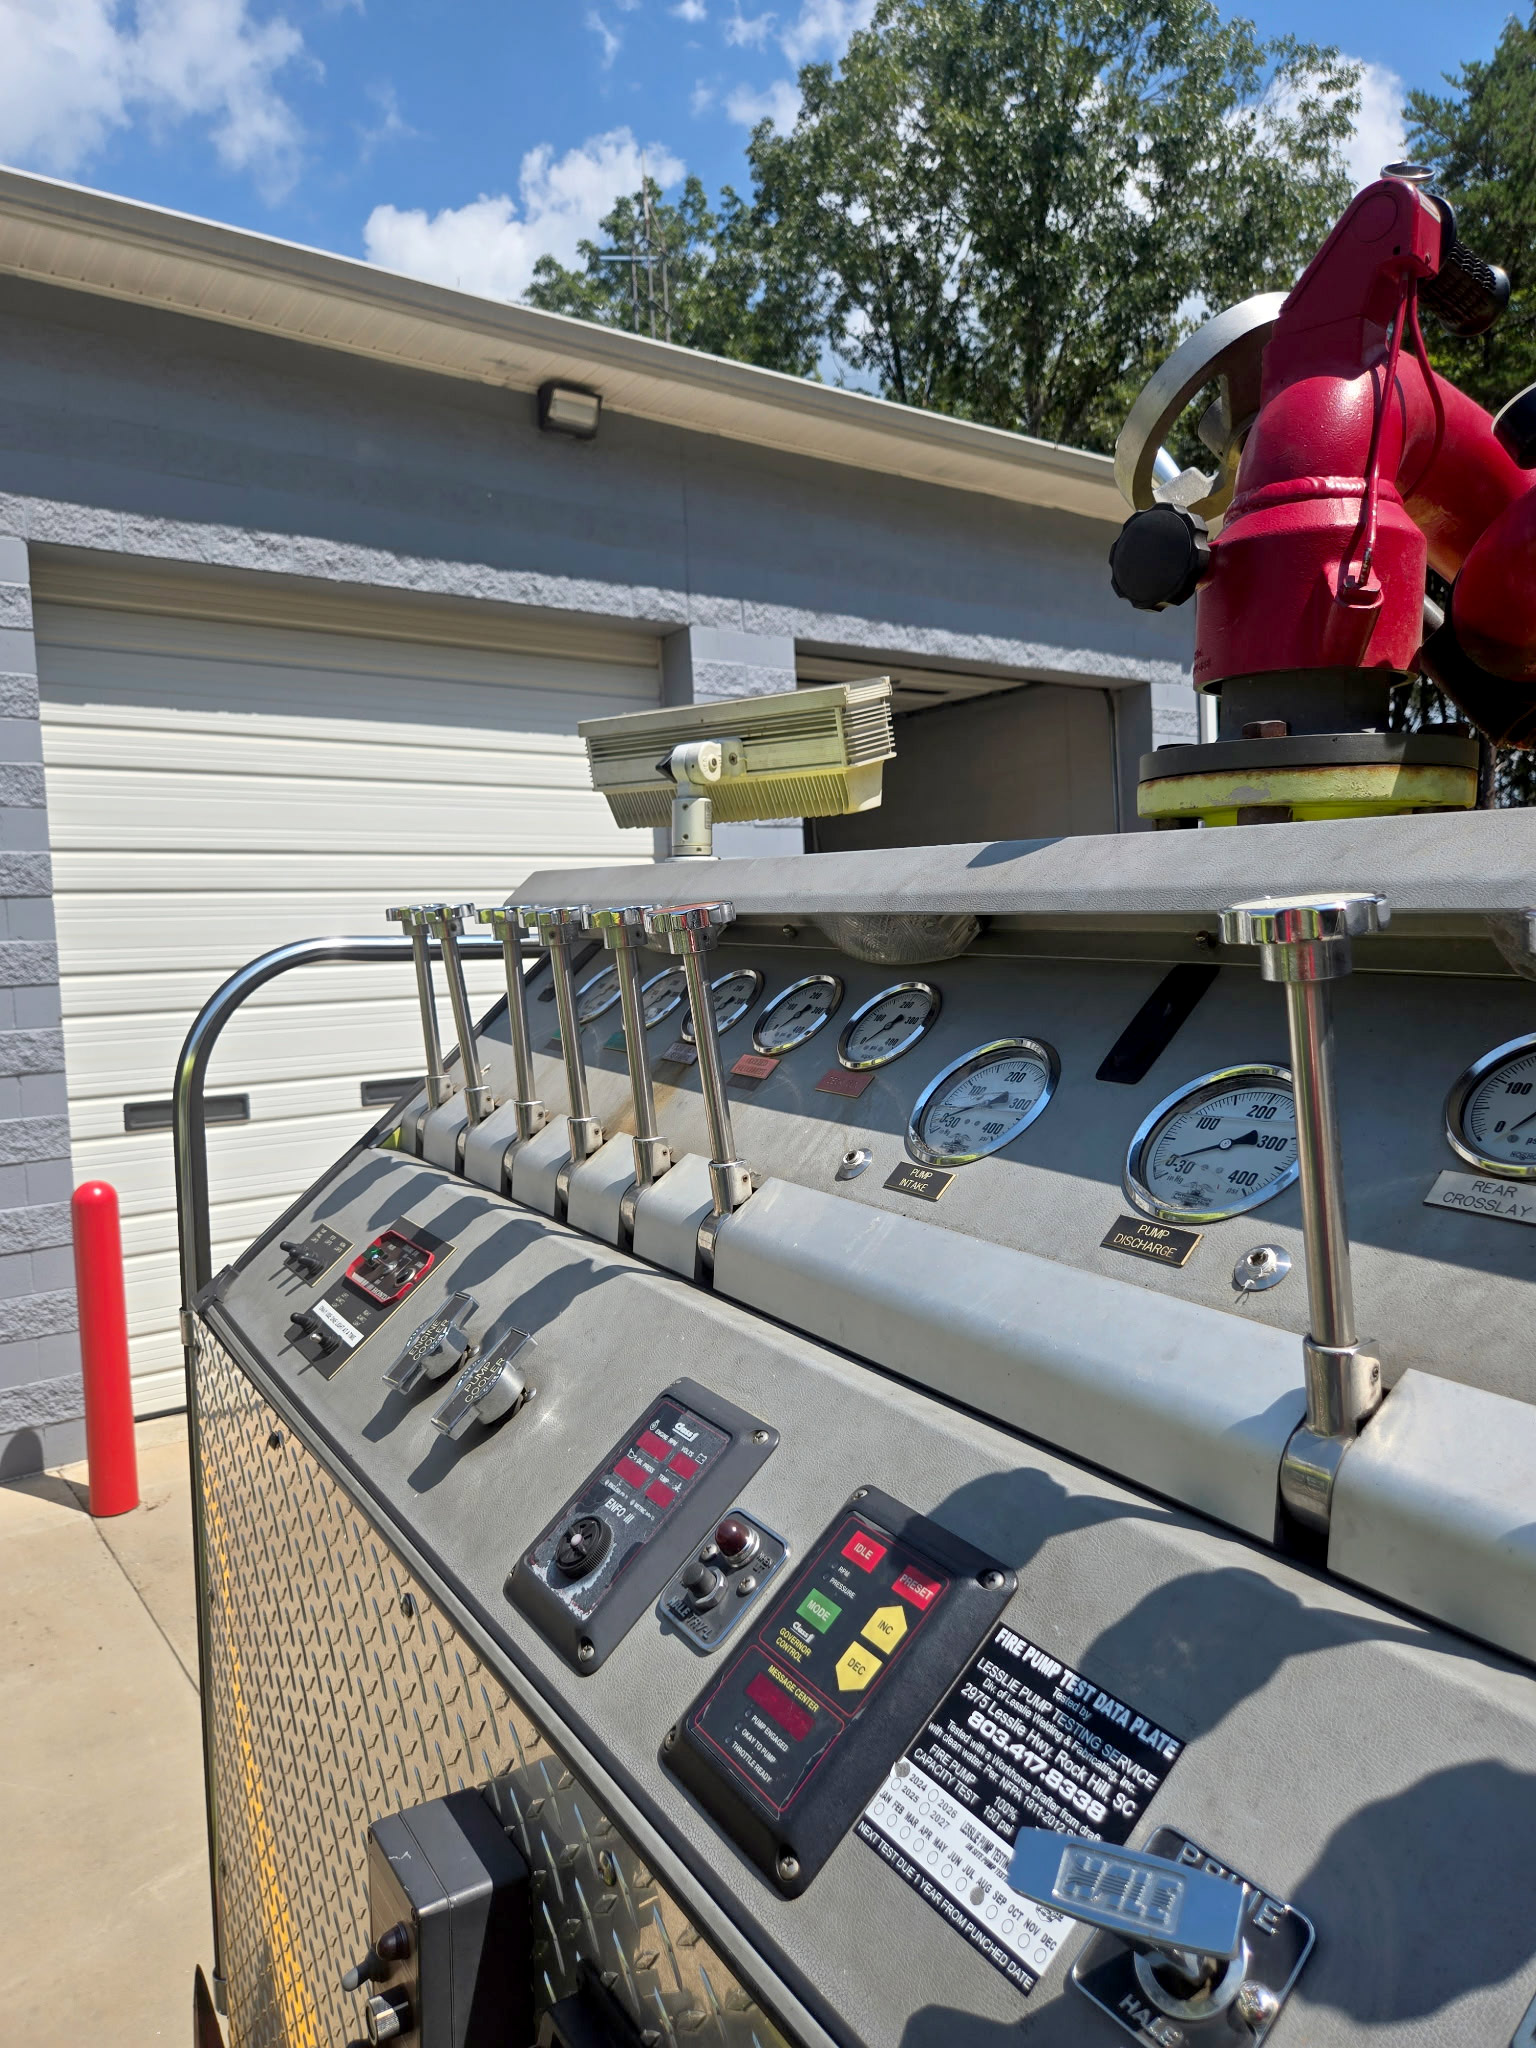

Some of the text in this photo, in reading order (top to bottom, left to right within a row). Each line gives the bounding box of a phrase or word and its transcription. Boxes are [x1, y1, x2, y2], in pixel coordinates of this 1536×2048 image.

[809, 991, 823, 1000] 200
[900, 1001, 914, 1010] 200
[811, 1006, 825, 1015] 300
[873, 1014, 887, 1022] 100
[904, 1016, 920, 1025] 300
[860, 1036, 868, 1044] 0
[885, 1037, 900, 1047] 400
[1004, 1071, 1026, 1083] 200
[968, 1085, 987, 1097] 100
[1505, 1081, 1533, 1096] 100
[1009, 1098, 1032, 1111] 300
[1246, 1105, 1277, 1120] 200
[982, 1122, 1005, 1135] 400
[1196, 1117, 1221, 1130] 100
[1494, 1120, 1506, 1133] 0
[1257, 1135, 1288, 1151] 300
[910, 1168, 933, 1180] PUMP
[1227, 1169, 1259, 1186] 400
[899, 1178, 928, 1192] INTAKE
[1226, 1186, 1239, 1195] psi
[1472, 1180, 1518, 1198] REAR
[1442, 1191, 1533, 1218] CROSSLAY
[1137, 1224, 1170, 1239] PUMP
[1113, 1233, 1178, 1258] DISCHARGE
[408, 1319, 441, 1356] ENGINE
[413, 1318, 449, 1361] COOLER
[464, 1361, 491, 1393] PUMP
[465, 1357, 505, 1403] COOLER
[655, 1429, 678, 1446] ENGINE RPM
[681, 1446, 694, 1457] VOLTS
[642, 1462, 655, 1474] PRESS
[658, 1474, 669, 1483] TEMP
[854, 1543, 873, 1561] IDLE
[838, 1566, 851, 1578] RPM
[829, 1577, 856, 1600] PRESSURE
[899, 1574, 934, 1601] PRESET
[668, 1595, 690, 1618] HALE
[806, 1599, 831, 1622] MODE
[877, 1620, 894, 1635] INC
[775, 1637, 803, 1663] CONTROL
[779, 1627, 812, 1657] GOVERNOR
[847, 1658, 866, 1675] DEC
[768, 1665, 820, 1712] MESSAGE CENTER
[995, 1627, 1180, 1760] FIRE PUMP TEST DATA PLATE
[1052, 1686, 1092, 1722] Tested by
[752, 1715, 789, 1752] PUMP ENGAGED
[977, 1657, 1159, 1790] LESSLIE PUMP TESTING SERVICE
[741, 1728, 777, 1763] OKAY TO PUMP
[982, 1677, 1136, 1794] Div. of Lesslie Welding & Fabricating, Inc.
[960, 1682, 1137, 1817] 2975 Lesslie Hwy. Rock Hill, SC
[731, 1741, 773, 1784] THROTTLE READY
[967, 1709, 1107, 1822] 803.417.8338
[928, 1721, 944, 1740] with
[942, 1734, 962, 1753] clean
[983, 1764, 999, 1782] Per.
[999, 1776, 1023, 1800] NFPA
[1023, 1796, 1068, 1833] 1911-2012
[929, 1744, 1020, 1821] FIRE PUMP 100%
[947, 1719, 972, 1742] Tested
[969, 1738, 986, 1757] with
[984, 1751, 991, 1760] a
[990, 1754, 1033, 1792] Workhorse
[1031, 1786, 1062, 1815] Drafter
[1059, 1807, 1080, 1829] from
[1079, 1820, 1102, 1841] draft
[909, 1773, 958, 1819] 2024 2026
[914, 1748, 1015, 1837] CAPACITY TEST 150 psi
[901, 1785, 950, 1830] 2025 2027
[978, 1836, 996, 1857] PUMP
[879, 1790, 891, 1804] JAN
[891, 1800, 904, 1817] FEB
[904, 1811, 920, 1828] MAR
[918, 1824, 932, 1841] APR
[932, 1836, 949, 1852] MAY
[947, 1851, 961, 1867] JUN
[961, 1864, 976, 1880] JUL
[976, 1876, 991, 1894] AUG
[992, 1890, 1008, 1906] SEP
[1007, 1904, 1024, 1920] OCT
[1023, 1918, 1041, 1936] NOV
[1040, 1932, 1058, 1951] DEC
[982, 1857, 998, 1873] PUMP
[857, 1820, 879, 1844] NEXT
[877, 1839, 898, 1863] TEST
[895, 1855, 915, 1879] DUE
[918, 1876, 942, 1904] YEAR
[940, 1896, 968, 1926] FROM
[965, 1920, 1010, 1967] PUNCHED
[1006, 1955, 1035, 1990] DATE
[1118, 1993, 1184, 2047] HALE
